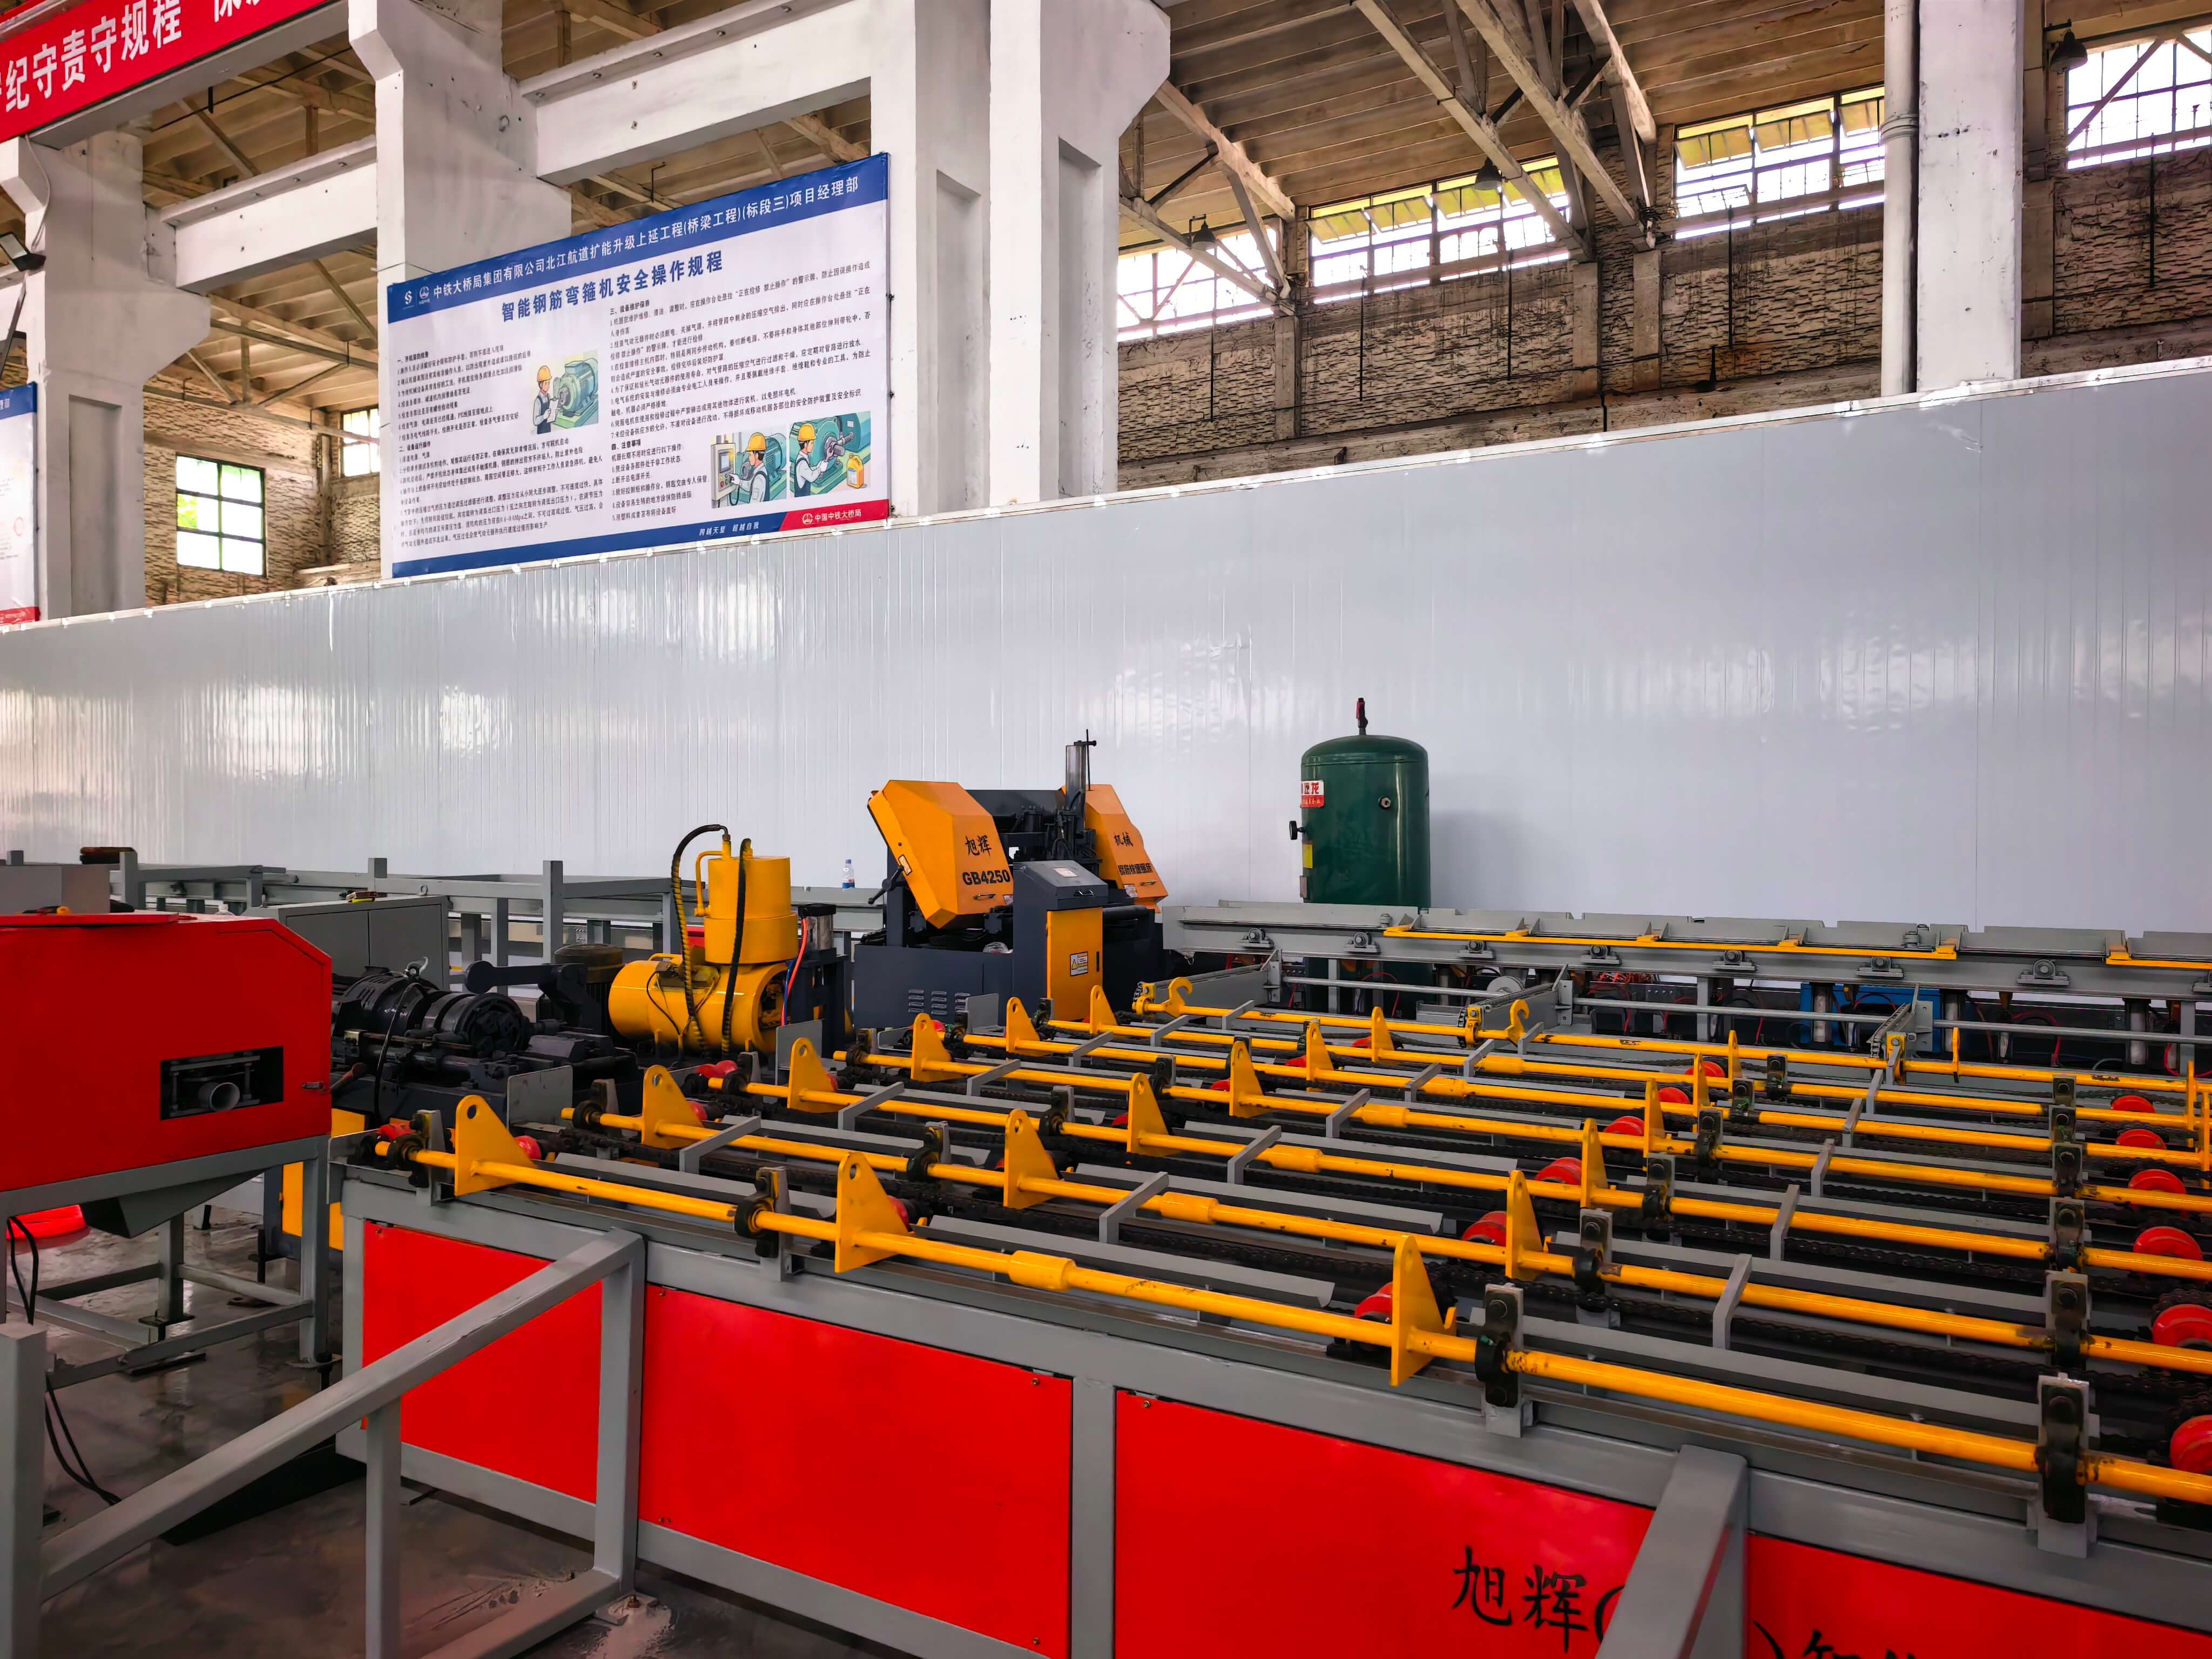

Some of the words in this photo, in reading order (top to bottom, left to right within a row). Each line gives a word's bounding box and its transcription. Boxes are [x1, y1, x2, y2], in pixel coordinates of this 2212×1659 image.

[0, 0, 182, 112] 纪守责守规程
[502, 250, 723, 322] 智能钢筋弯箍机安全操作规程
[611, 439, 640, 450] 四、注意事项
[814, 508, 861, 522] 中国中铁大桥局
[965, 835, 992, 857] 旭辉
[1114, 832, 1134, 847] 机械
[962, 869, 1010, 886] GB4250
